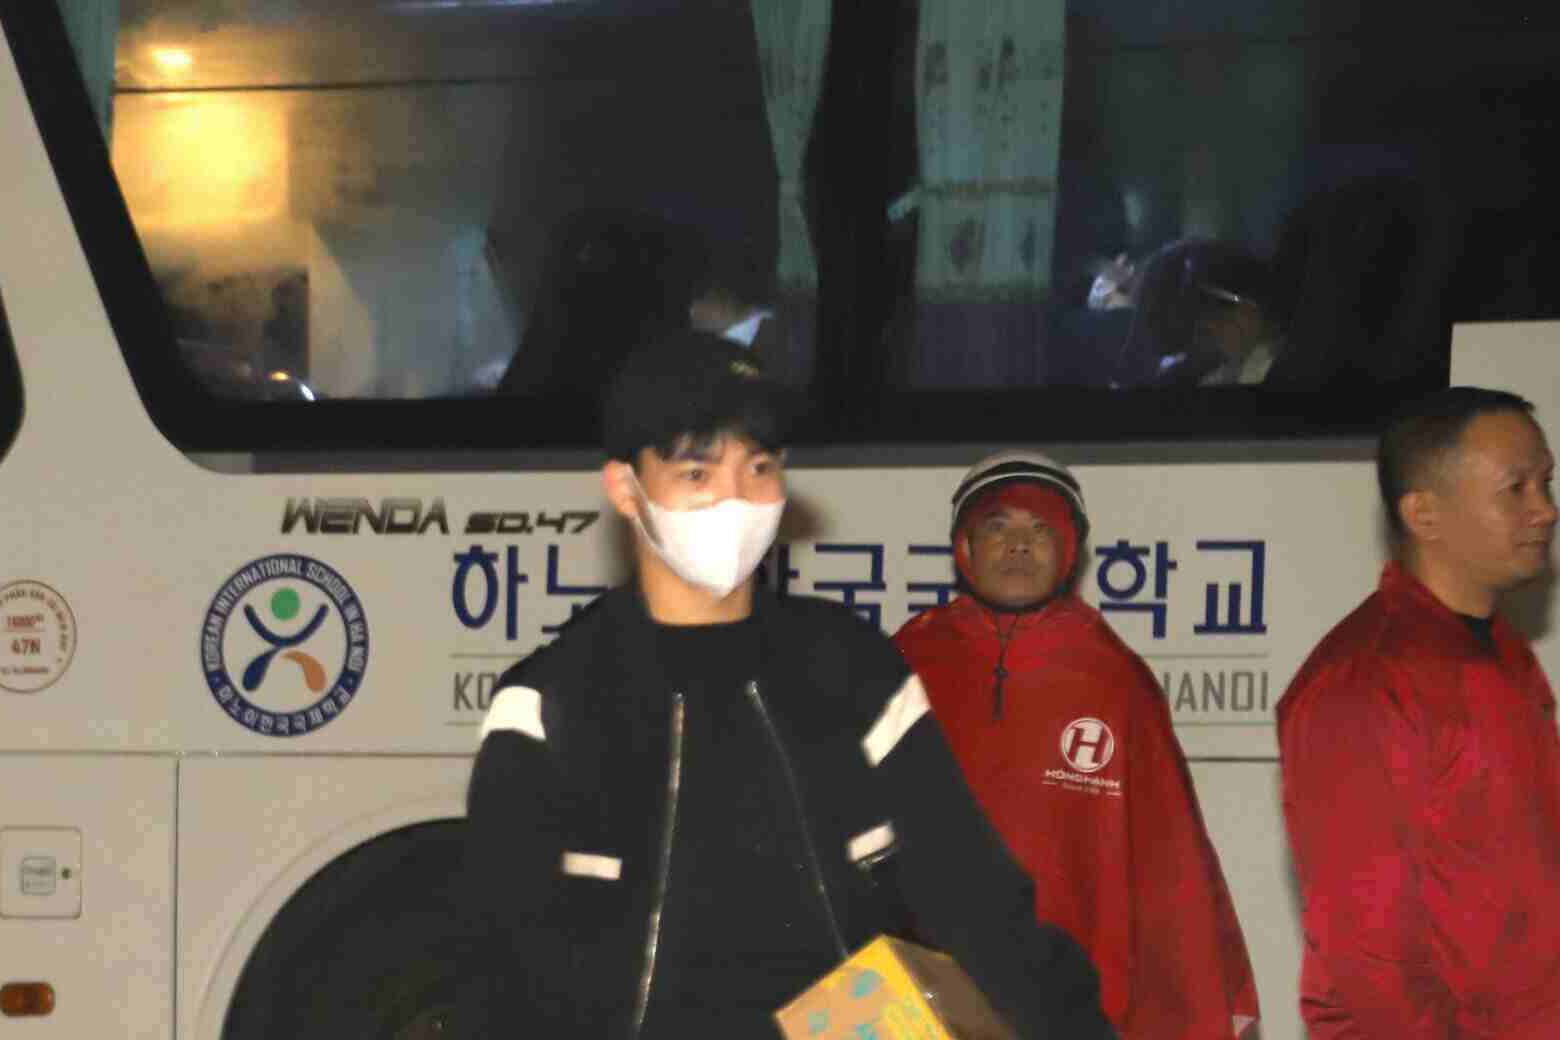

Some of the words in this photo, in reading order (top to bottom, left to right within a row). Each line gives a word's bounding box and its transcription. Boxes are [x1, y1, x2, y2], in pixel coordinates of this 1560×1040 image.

[281, 497, 450, 536] WENDA
[213, 558, 304, 613] INTERNATIONAL
[306, 561, 352, 606] SCHOOL
[1163, 670, 1269, 713] ANOI
